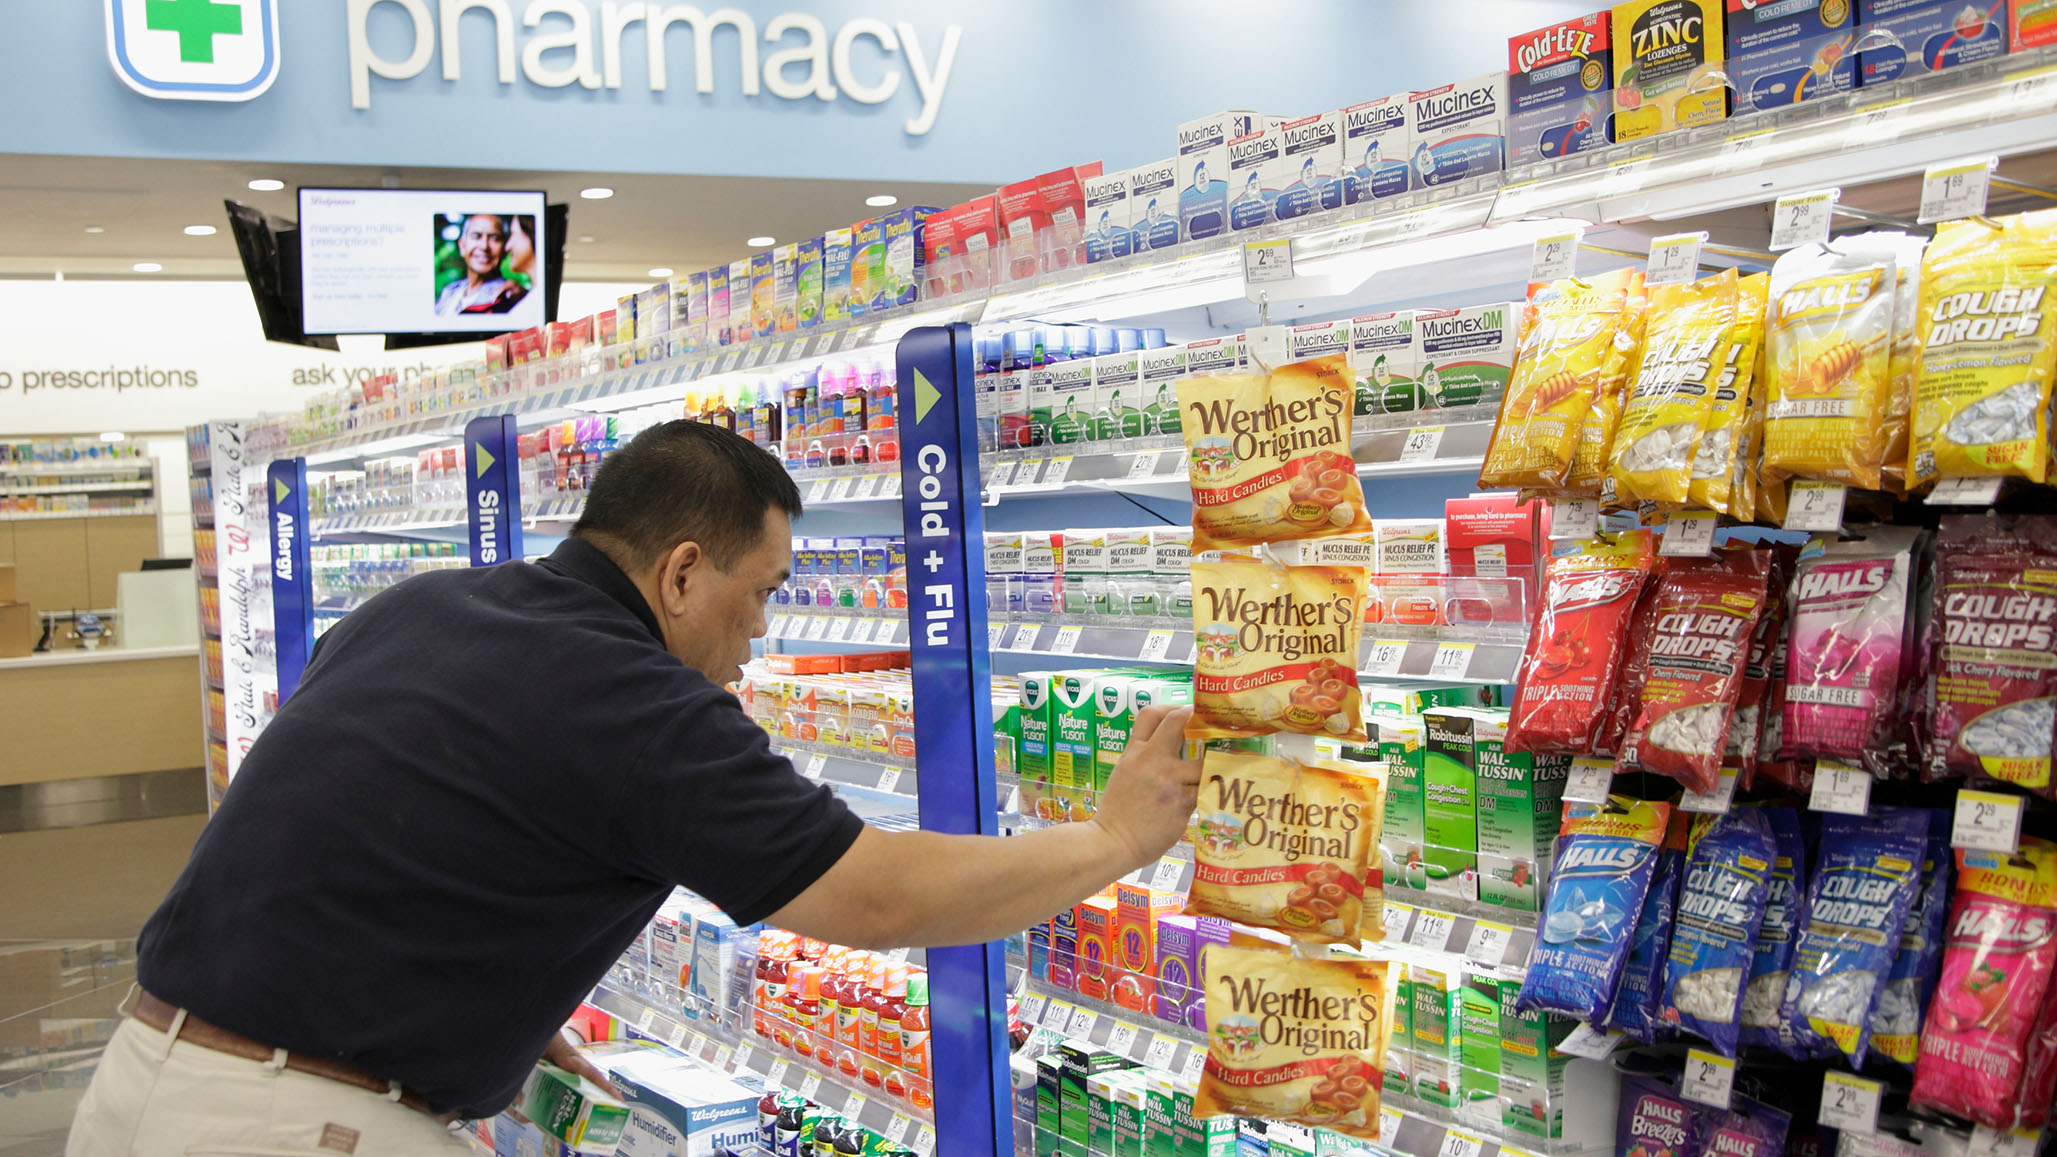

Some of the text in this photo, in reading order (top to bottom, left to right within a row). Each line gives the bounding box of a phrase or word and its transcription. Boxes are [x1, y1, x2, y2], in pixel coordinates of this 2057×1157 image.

[1758, 7, 1780, 19] COLD
[1632, 17, 1701, 59] ZINC
[1647, 43, 1687, 61] LOZENGES
[345, 0, 963, 136] pharmacy
[1417, 85, 1494, 121] Mucinex
[1348, 104, 1403, 128] Mucinex
[1179, 122, 1223, 145] Mucinex
[1284, 122, 1335, 145] Mucinex
[1441, 122, 1470, 134] EXPECTORANT
[1618, 130, 1626, 140] 18
[1230, 137, 1278, 161] Mucinex
[1132, 167, 1174, 187] Mucinex
[1086, 180, 1126, 199] Mucinex
[1781, 276, 1874, 316] HALLS
[1932, 284, 2047, 322] COUGH
[1927, 312, 2043, 347] DROPS
[1472, 346, 1500, 355] SUPPRESSANT
[22, 364, 199, 395] prescriptions
[292, 362, 336, 385] ask
[1316, 369, 1340, 379] STORCK
[1190, 386, 1344, 435] Werther's
[1813, 402, 1845, 414] FREE
[1232, 414, 1342, 462] Original
[917, 444, 950, 537] Cold
[1198, 471, 1283, 505] Hard Candies
[478, 489, 499, 563] Sinus
[276, 512, 294, 581] Allergy
[1323, 545, 1370, 554] MUCUS RELIEF PE
[1384, 544, 1435, 553] MUCUS RELIEF PE
[1800, 566, 1885, 600] HALLS
[925, 584, 954, 646] Flu
[1202, 587, 1352, 626] Werther's
[1945, 592, 2054, 621] COUGH
[1657, 613, 1743, 638] COUGH
[1945, 619, 2054, 650] DROPS
[1238, 622, 1346, 661] Original
[1650, 635, 1735, 661] DROPS
[1199, 670, 1285, 692] Hard Candies
[1653, 668, 1702, 681] Cherry Flavored
[1964, 663, 2040, 681] Cherry Flavored
[1789, 688, 1858, 704] SUGAR FREE
[1021, 714, 1048, 731] Nature
[1058, 713, 1088, 730] Nature
[1096, 724, 1126, 740] Nature
[1023, 730, 1045, 742] Fusion
[1061, 728, 1085, 741] Fusion
[1099, 739, 1124, 751] Fusion
[1429, 729, 1472, 744] Robitussin
[1443, 742, 1472, 752] PEAK COLD
[1479, 751, 1510, 766] WAL-
[1478, 765, 1525, 781] TUSSIN
[1210, 775, 1361, 832] Werther's
[1427, 792, 1461, 805] Congestion
[1479, 796, 1495, 810] DM
[1535, 801, 1553, 812] DM
[1243, 816, 1350, 862] Original
[1559, 847, 1639, 871] HALLS
[1197, 864, 1285, 883] Hard Candies
[1687, 869, 1753, 901] COUGH
[1117, 887, 1149, 909] Delsym
[1822, 876, 1898, 903] COUGH
[1081, 907, 1105, 926] Delsym
[1681, 893, 1748, 925] DROPS
[1813, 899, 1887, 927] DROPS
[1161, 926, 1190, 946] Delsym
[1953, 909, 2046, 942] HALLS
[1087, 938, 1099, 960] 12
[1126, 931, 1140, 955] 12
[1167, 962, 1181, 985] 12
[1220, 975, 1378, 1022] Werther's
[1415, 1001, 1446, 1017] TUSSIN
[1260, 1013, 1369, 1056] Original
[1516, 1034, 1536, 1045] MAX
[610, 1073, 638, 1098] Walgreens
[1217, 1066, 1304, 1085] Hard Candies
[690, 1105, 748, 1122] Walgreens
[1088, 1109, 1110, 1122] TUSSIN
[1146, 1110, 1173, 1126] TUSSIN
[1173, 1111, 1205, 1131] TUSSIN
[1643, 1100, 1683, 1124] HALLS
[632, 1111, 677, 1148] Humidifier
[1116, 1118, 1138, 1131] TUSSIN
[1632, 1115, 1687, 1147] Breezers
[1716, 1134, 1755, 1157] HALLS
